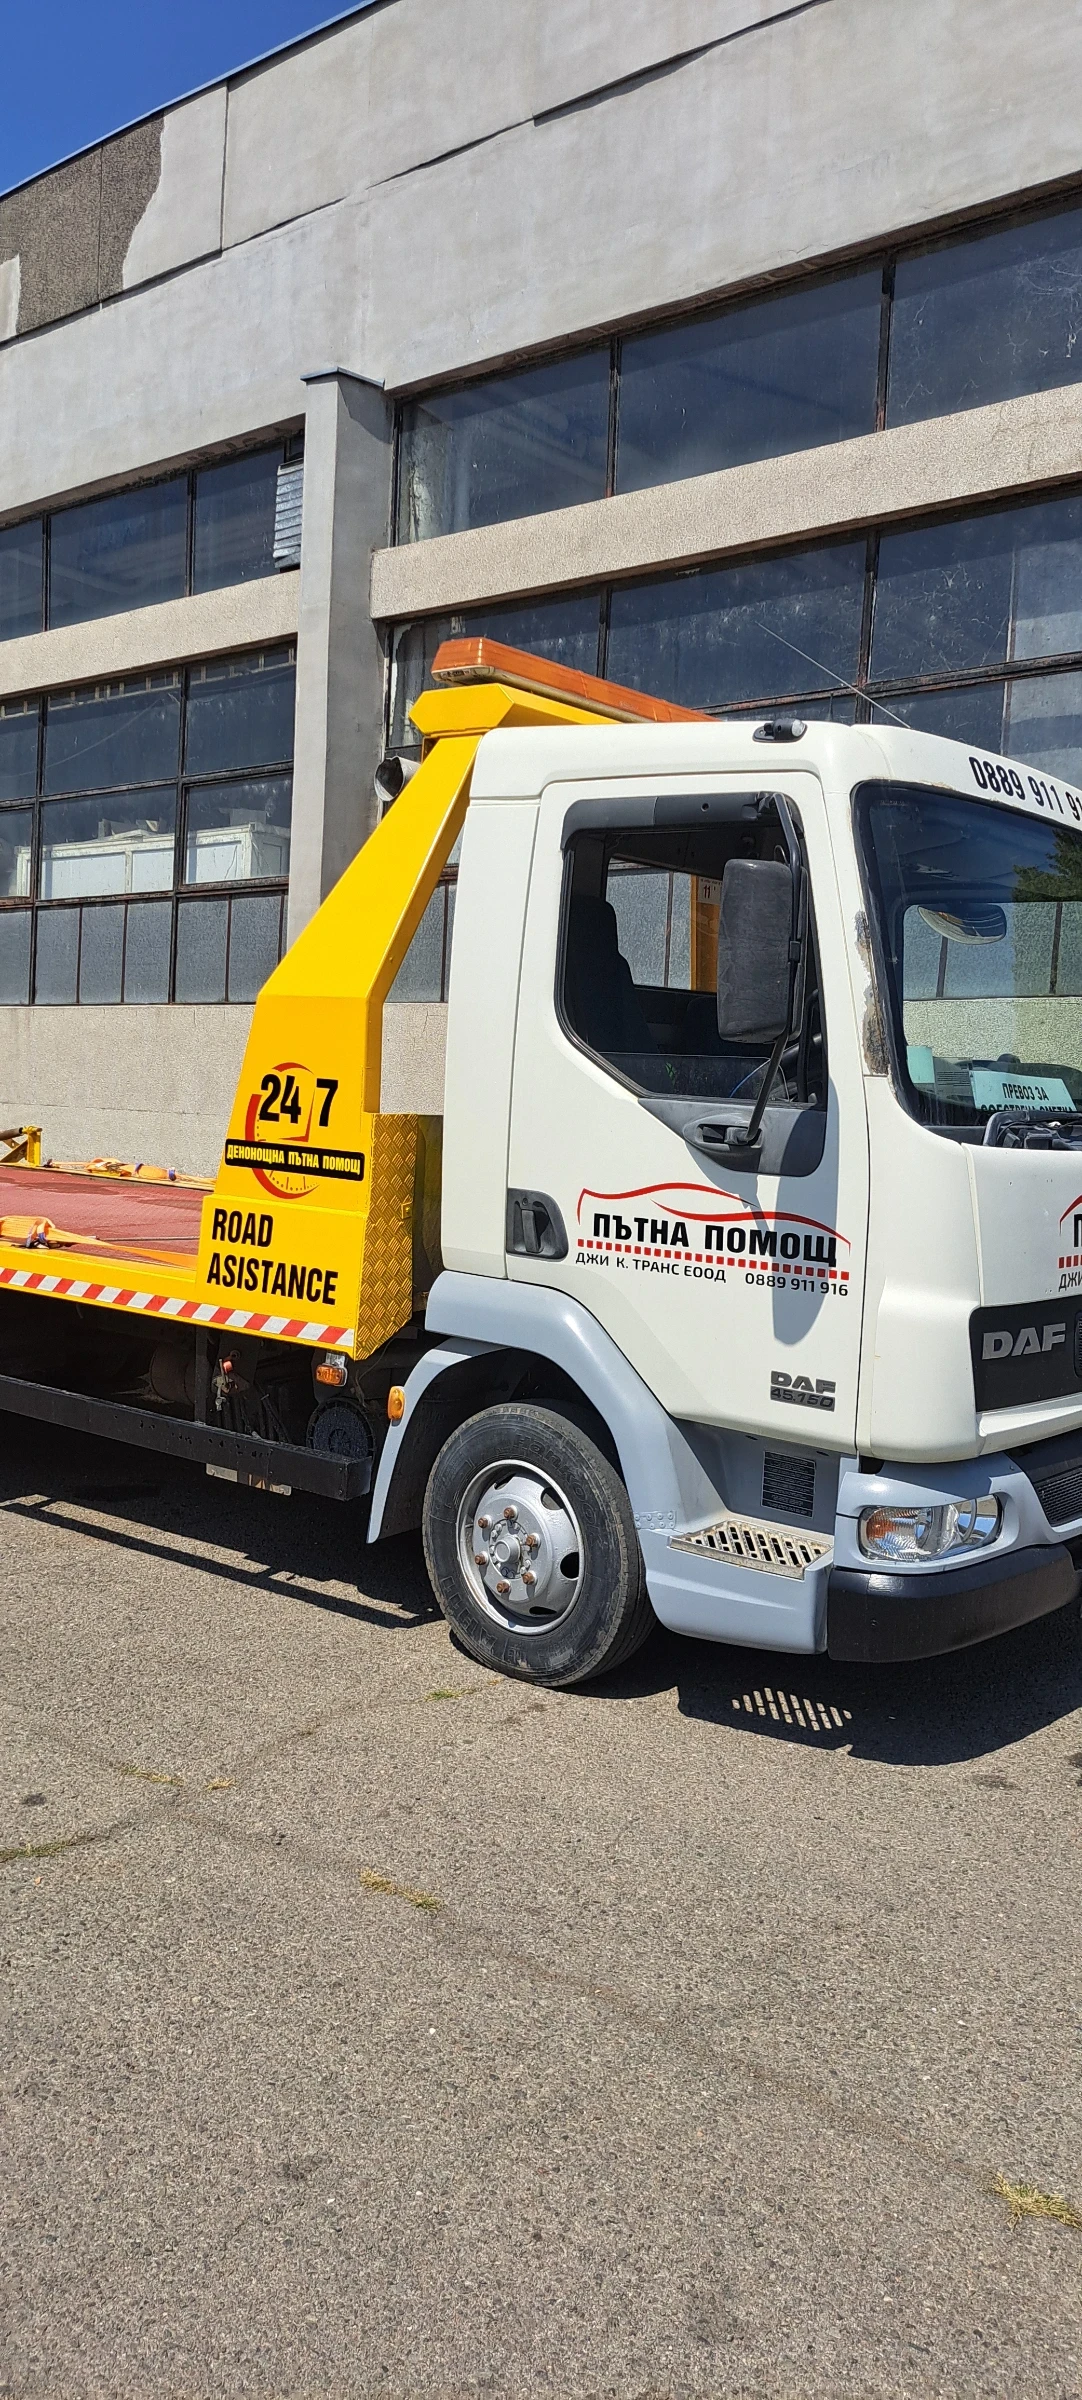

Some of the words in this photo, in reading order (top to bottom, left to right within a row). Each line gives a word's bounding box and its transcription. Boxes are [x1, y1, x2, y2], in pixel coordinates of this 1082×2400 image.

[969, 757, 1026, 801] 0889
[1028, 775, 1064, 815] 911
[259, 1073, 302, 1125] 24
[316, 1078, 339, 1128] 7
[1002, 1082, 1036, 1101] ПРЕВОЗ
[1035, 1086, 1050, 1102] ЗА
[227, 1144, 285, 1164] ДЕНОНОЩНА
[288, 1150, 320, 1169] ПЪТНА
[322, 1155, 361, 1175] ПОМОЩ
[211, 1207, 274, 1248] ROAD
[593, 1212, 690, 1248] ПЪТНА
[704, 1223, 837, 1268] ПОМОЩ
[206, 1252, 339, 1306] ASISTANCE
[575, 1252, 610, 1267] ДЖИ
[632, 1258, 680, 1276] ТРАНС
[684, 1265, 727, 1284] ЕООД
[745, 1272, 787, 1289] 0889
[790, 1279, 815, 1293] 911
[820, 1283, 849, 1297] 916
[981, 1322, 1067, 1360] DAF
[770, 1370, 837, 1395] DAF
[770, 1387, 835, 1409] 45.150
